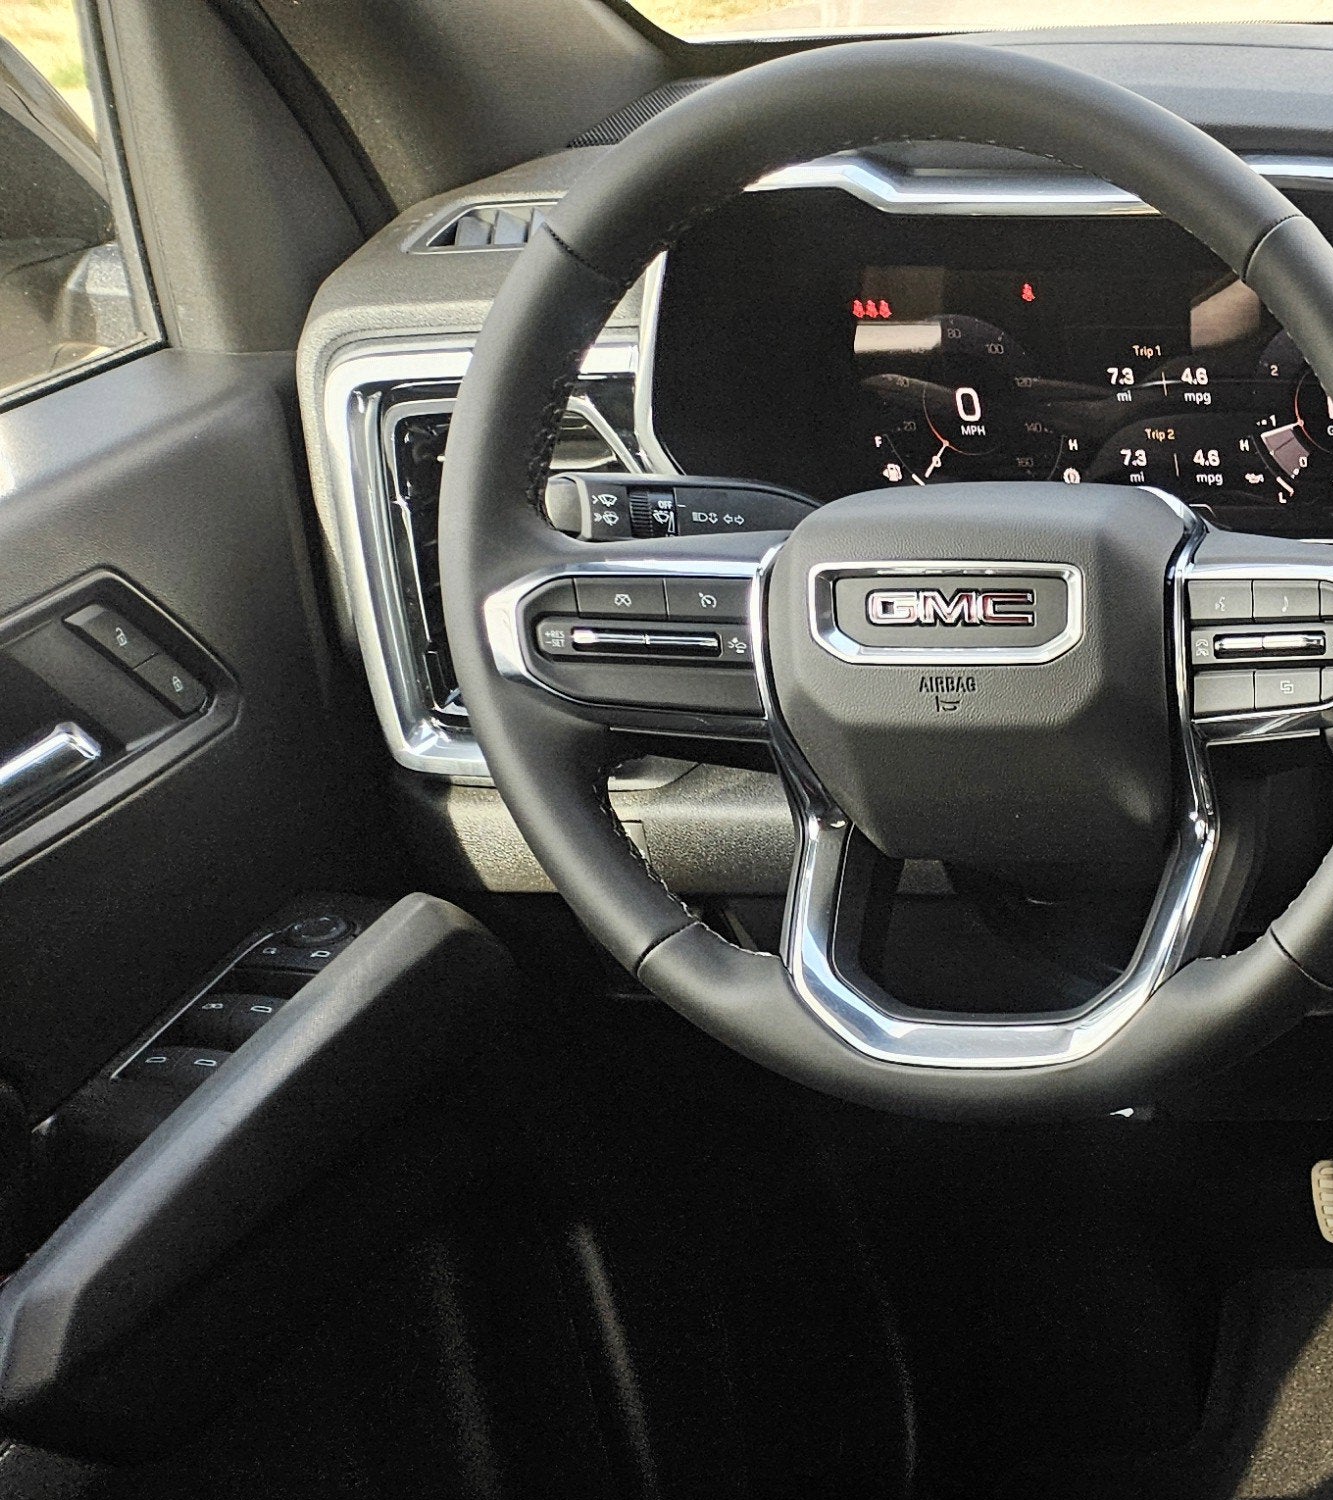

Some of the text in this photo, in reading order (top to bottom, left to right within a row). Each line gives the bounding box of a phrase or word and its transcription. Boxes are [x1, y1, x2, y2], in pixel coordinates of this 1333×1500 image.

[1132, 345, 1162, 359] Trip 1
[1107, 367, 1134, 385] 7.3
[1181, 367, 1208, 385] 4.6
[1270, 365, 1279, 376] 2
[1117, 390, 1132, 402] mi
[1184, 392, 1212, 405] mpg
[955, 387, 981, 421] 0
[961, 425, 985, 436] MPH
[1145, 428, 1175, 442] Trip 2
[875, 435, 882, 447] F
[1068, 439, 1078, 450] H
[1240, 440, 1249, 451] H
[1120, 449, 1147, 467] 7.3
[1193, 449, 1220, 467] 4.6
[1130, 472, 1145, 482] mi
[1196, 474, 1223, 486] mpg
[658, 501, 673, 509] OFF
[866, 588, 1035, 626] GMC
[918, 676, 976, 694] AIRBAG
